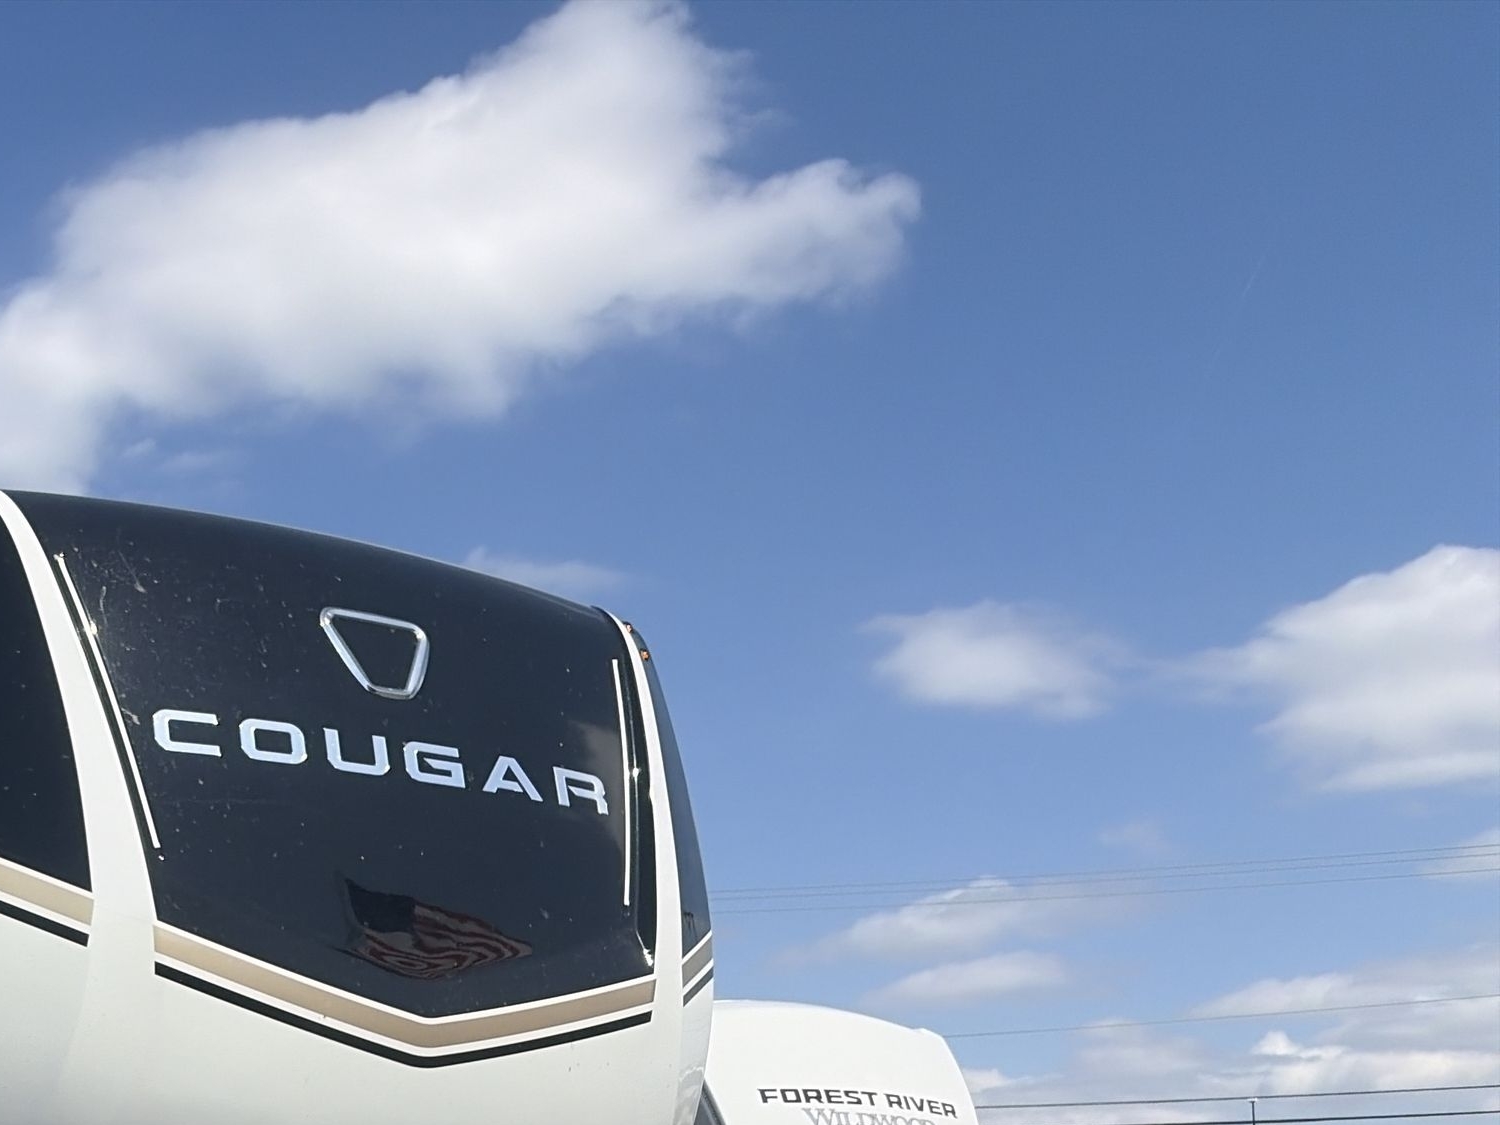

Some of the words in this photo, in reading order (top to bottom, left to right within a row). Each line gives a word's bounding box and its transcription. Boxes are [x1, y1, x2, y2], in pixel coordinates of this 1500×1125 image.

[152, 708, 609, 815] COUGAR
[757, 1088, 878, 1106] FOREST
[883, 1093, 958, 1119] RIVER
